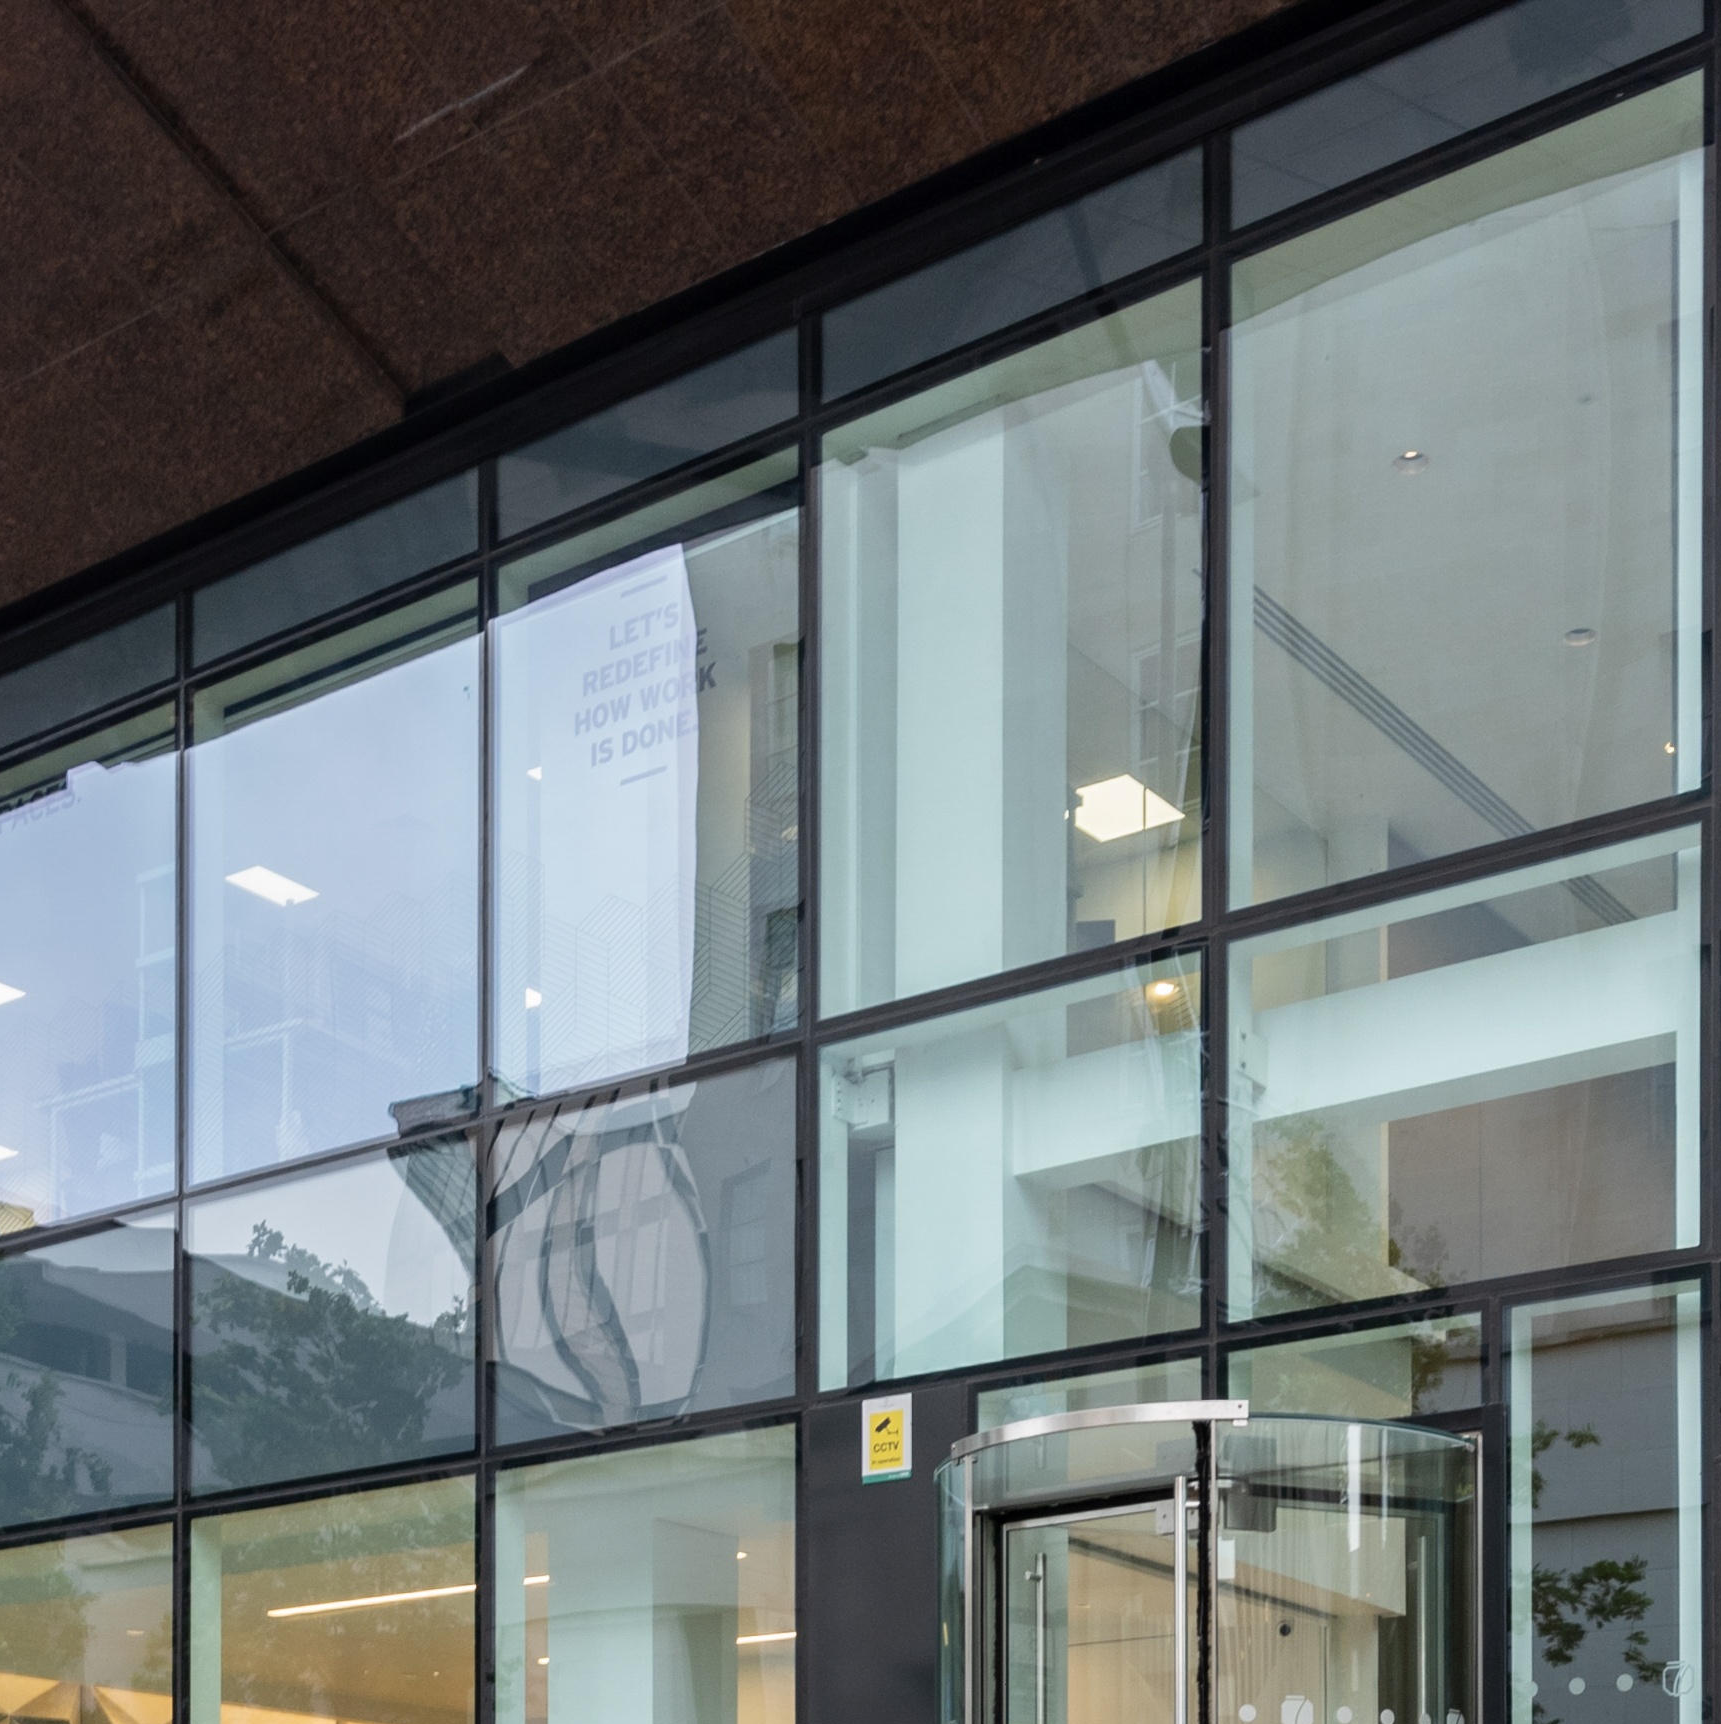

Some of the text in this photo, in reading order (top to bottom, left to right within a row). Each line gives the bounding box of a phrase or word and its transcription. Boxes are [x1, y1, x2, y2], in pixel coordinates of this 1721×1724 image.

[609, 601, 680, 651] LET'S
[583, 627, 708, 697] REDEFINE
[574, 662, 717, 737] HOW WORK
[591, 737, 614, 768] IS
[873, 1441, 900, 1453] CCTV
